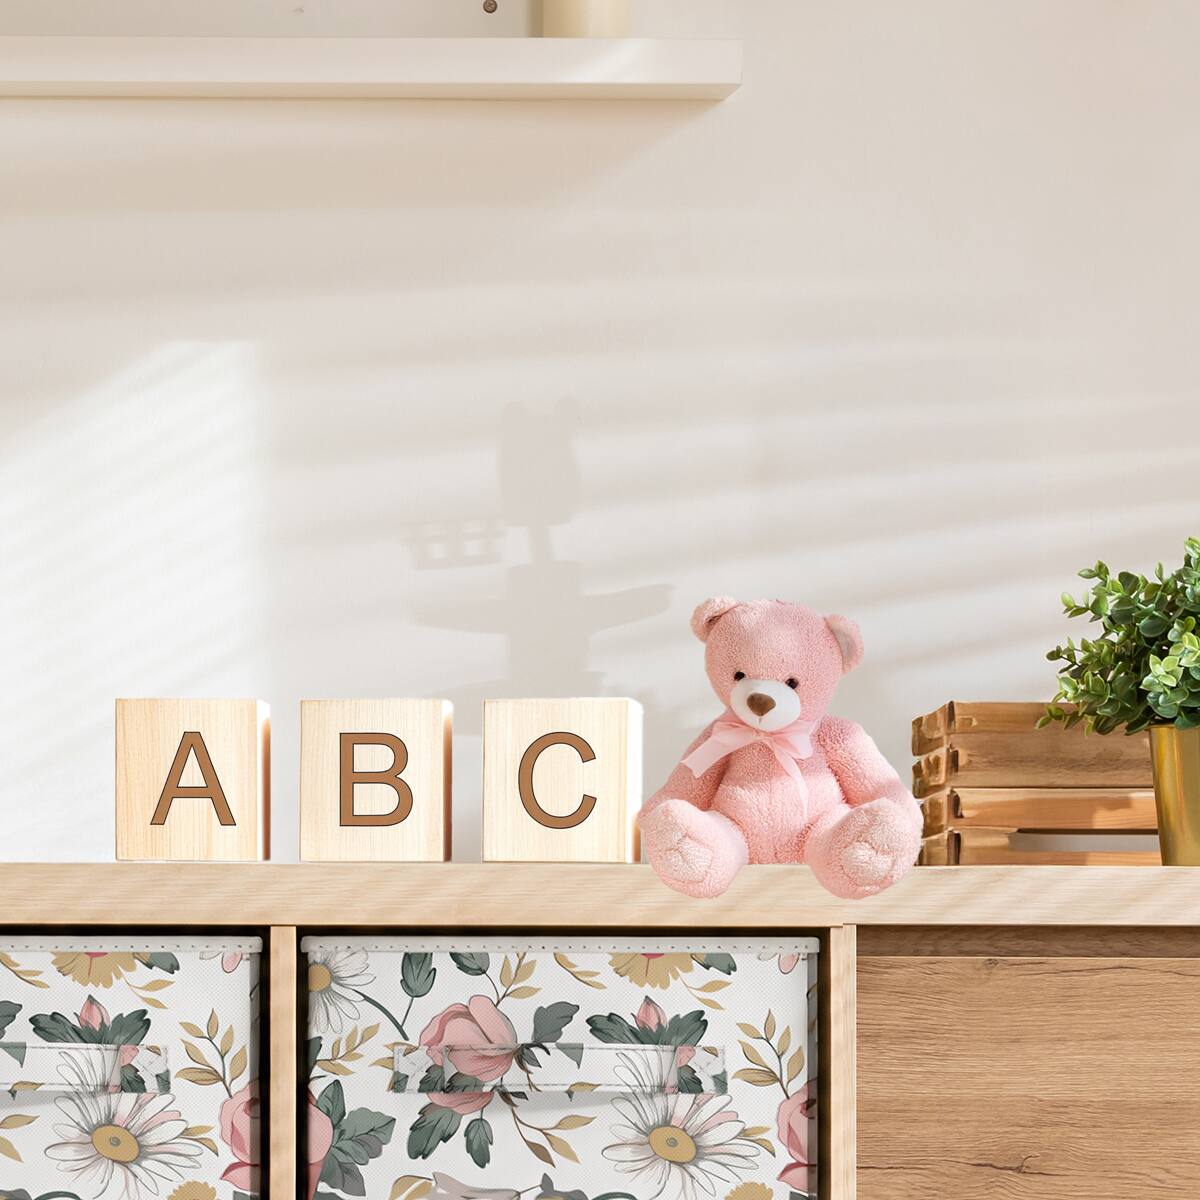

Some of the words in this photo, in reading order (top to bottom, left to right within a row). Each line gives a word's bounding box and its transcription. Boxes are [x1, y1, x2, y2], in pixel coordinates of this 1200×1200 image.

[150, 731, 237, 826] A
[339, 732, 414, 827] B
[518, 731, 597, 829] C
